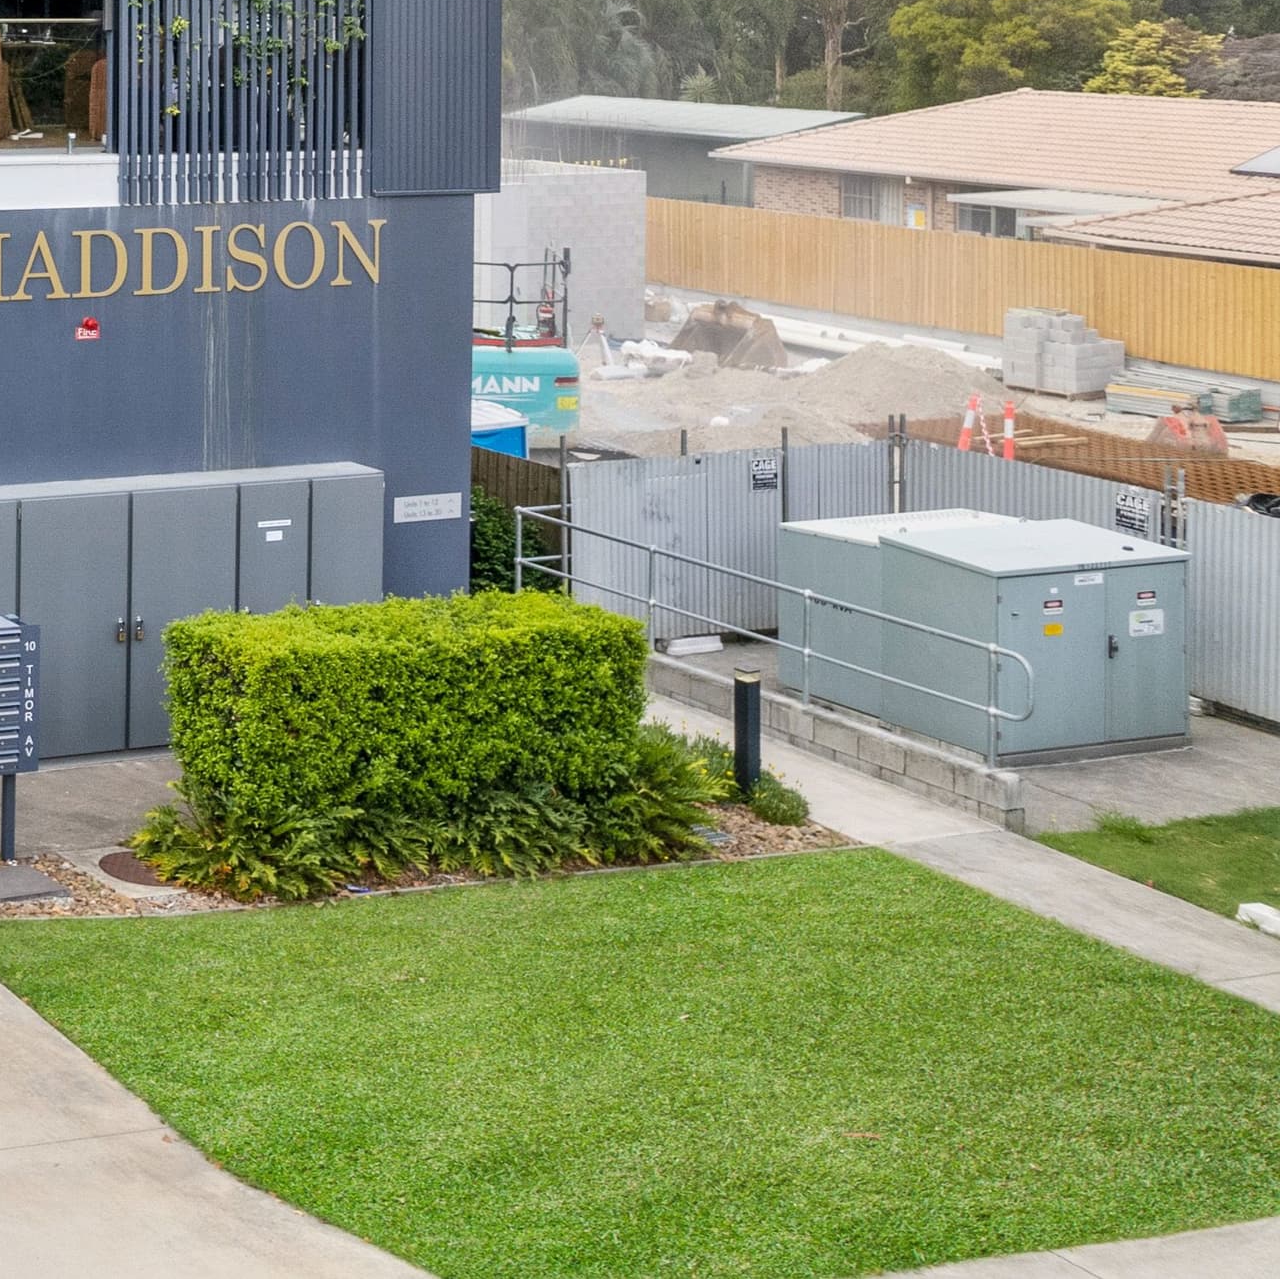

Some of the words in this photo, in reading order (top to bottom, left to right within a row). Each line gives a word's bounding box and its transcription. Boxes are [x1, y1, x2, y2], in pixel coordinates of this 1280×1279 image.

[752, 460, 777, 471] CAGE
[1116, 493, 1150, 511] CAGE
[24, 640, 36, 652] 10
[24, 664, 34, 722] TIMOR
[25, 734, 33, 757] AV
